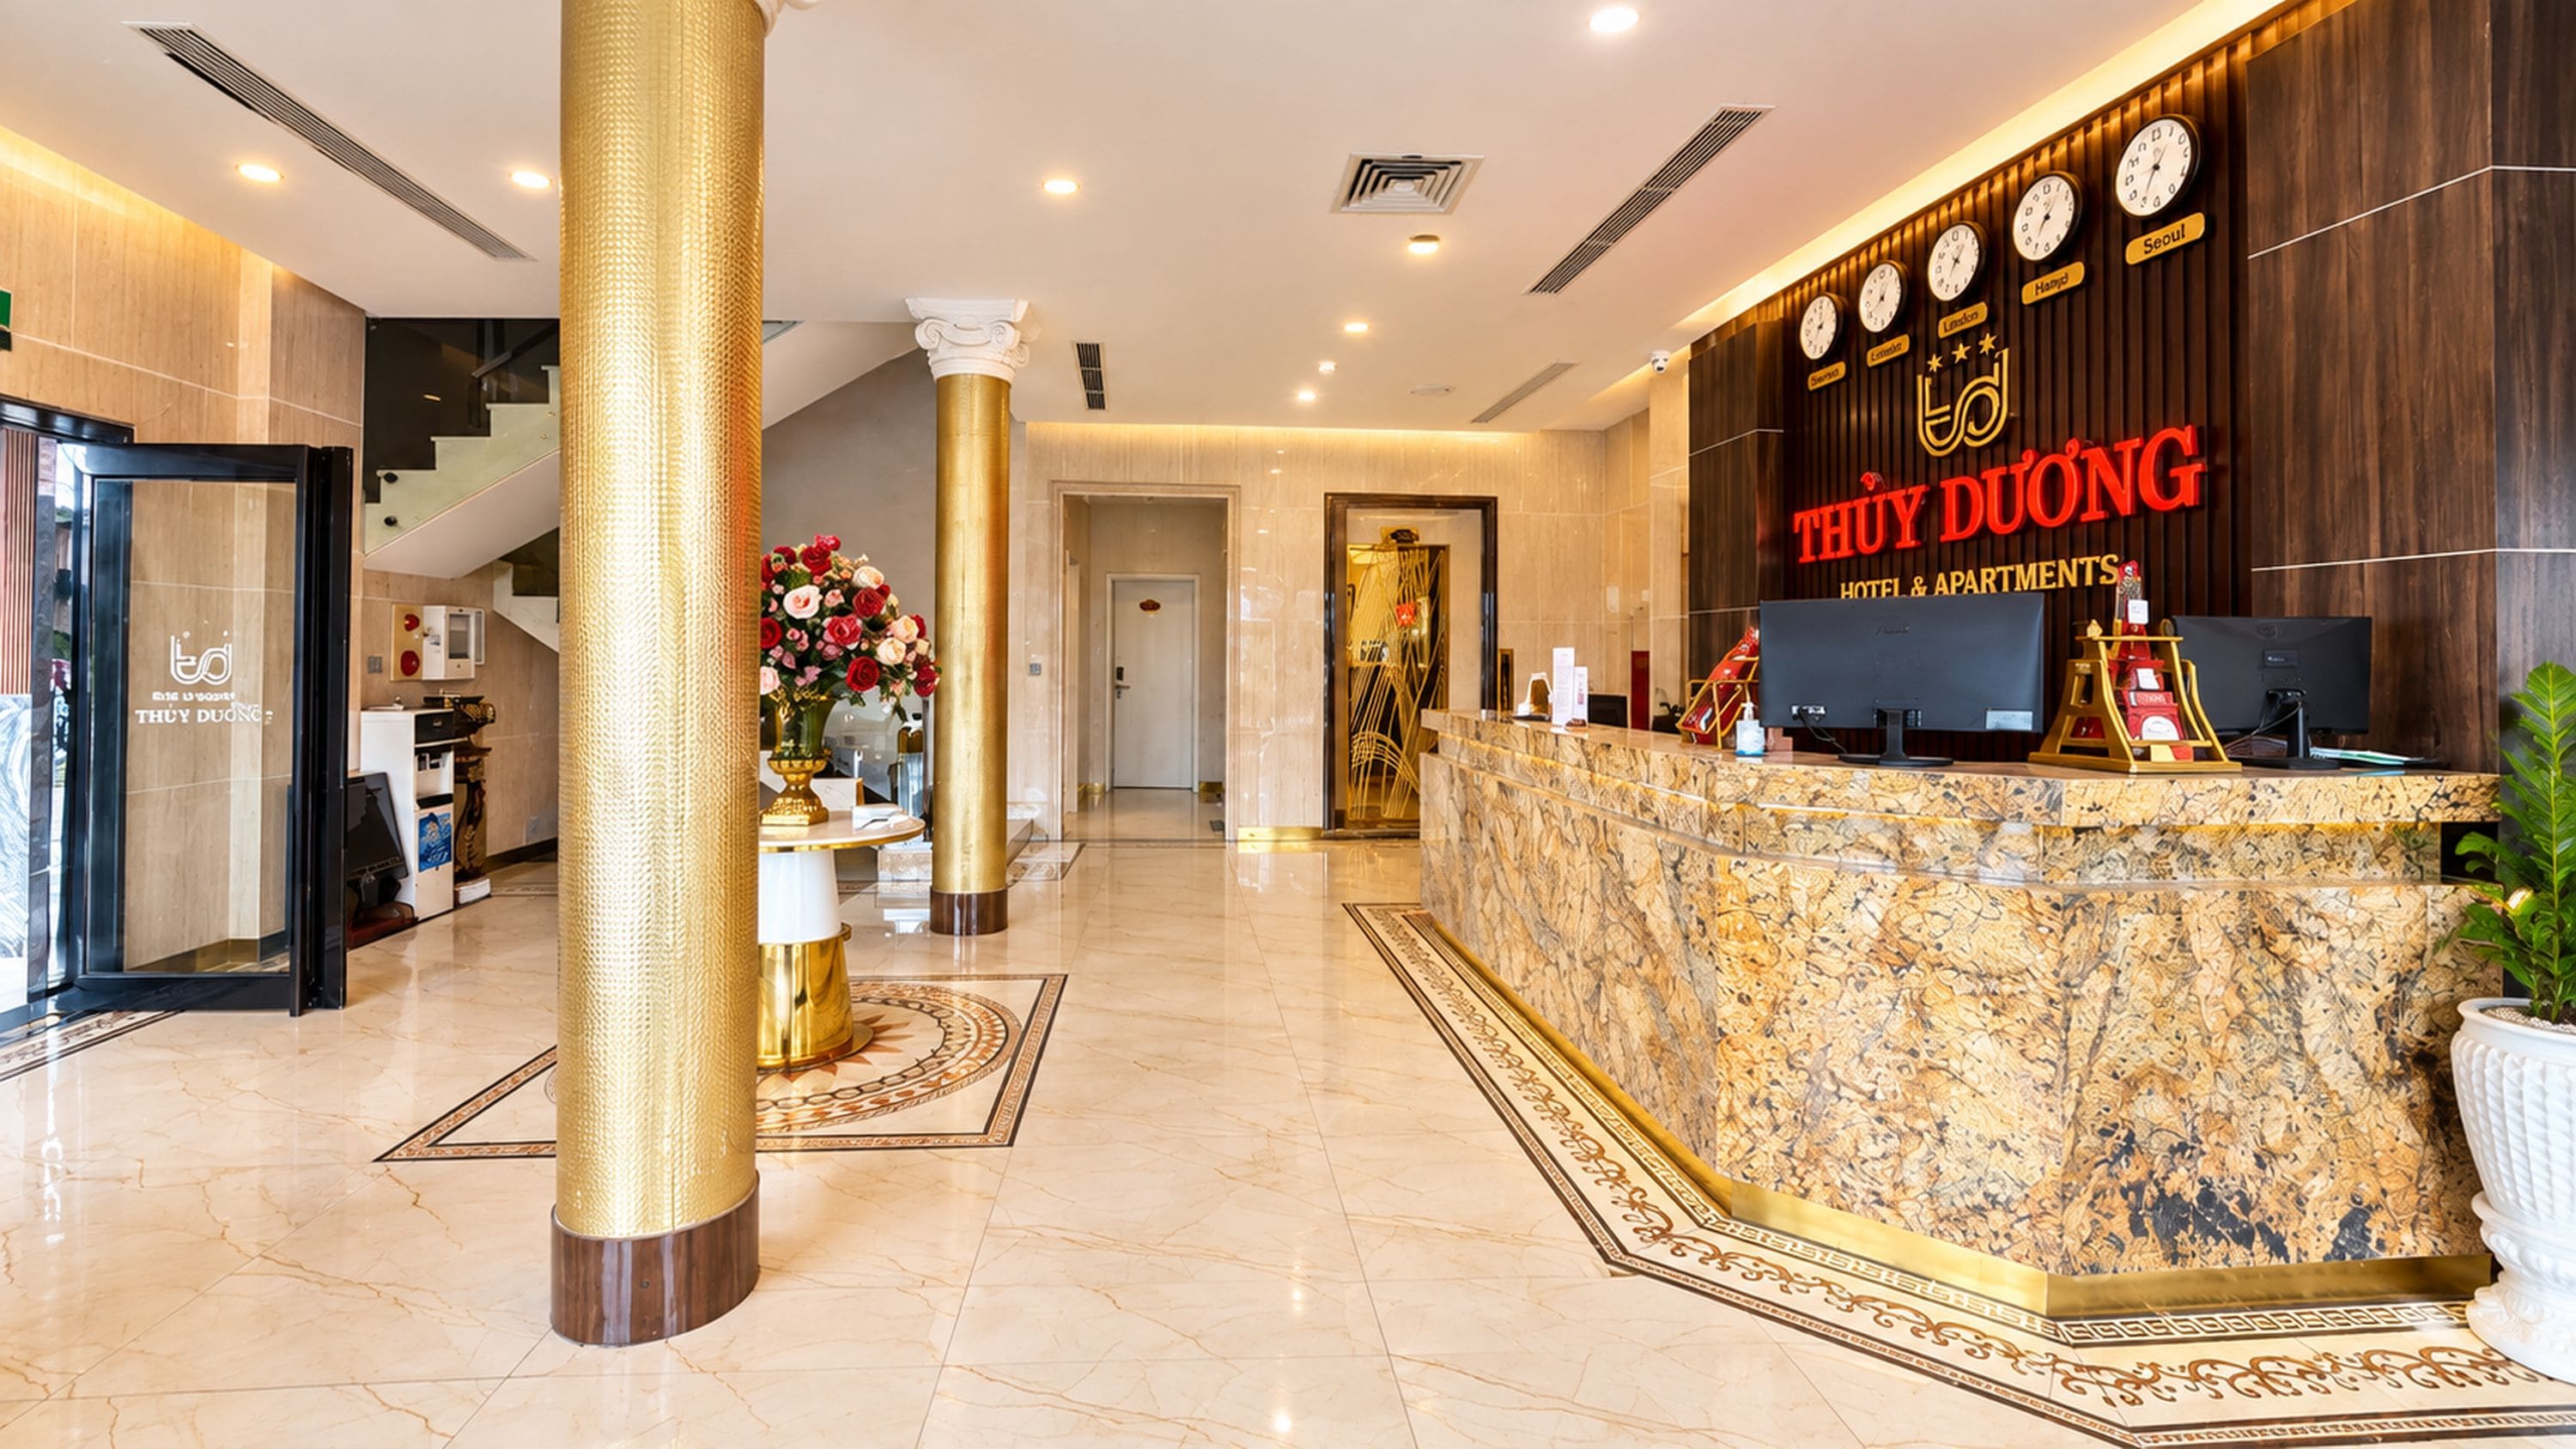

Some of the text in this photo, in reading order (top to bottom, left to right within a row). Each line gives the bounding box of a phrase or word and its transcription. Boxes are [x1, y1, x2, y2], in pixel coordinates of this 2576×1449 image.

[2143, 223, 2186, 255] Seoul
[1793, 424, 2207, 564] THỦY DƯƠNG
[1840, 554, 2119, 600] HOTEL & APARTMENTS
